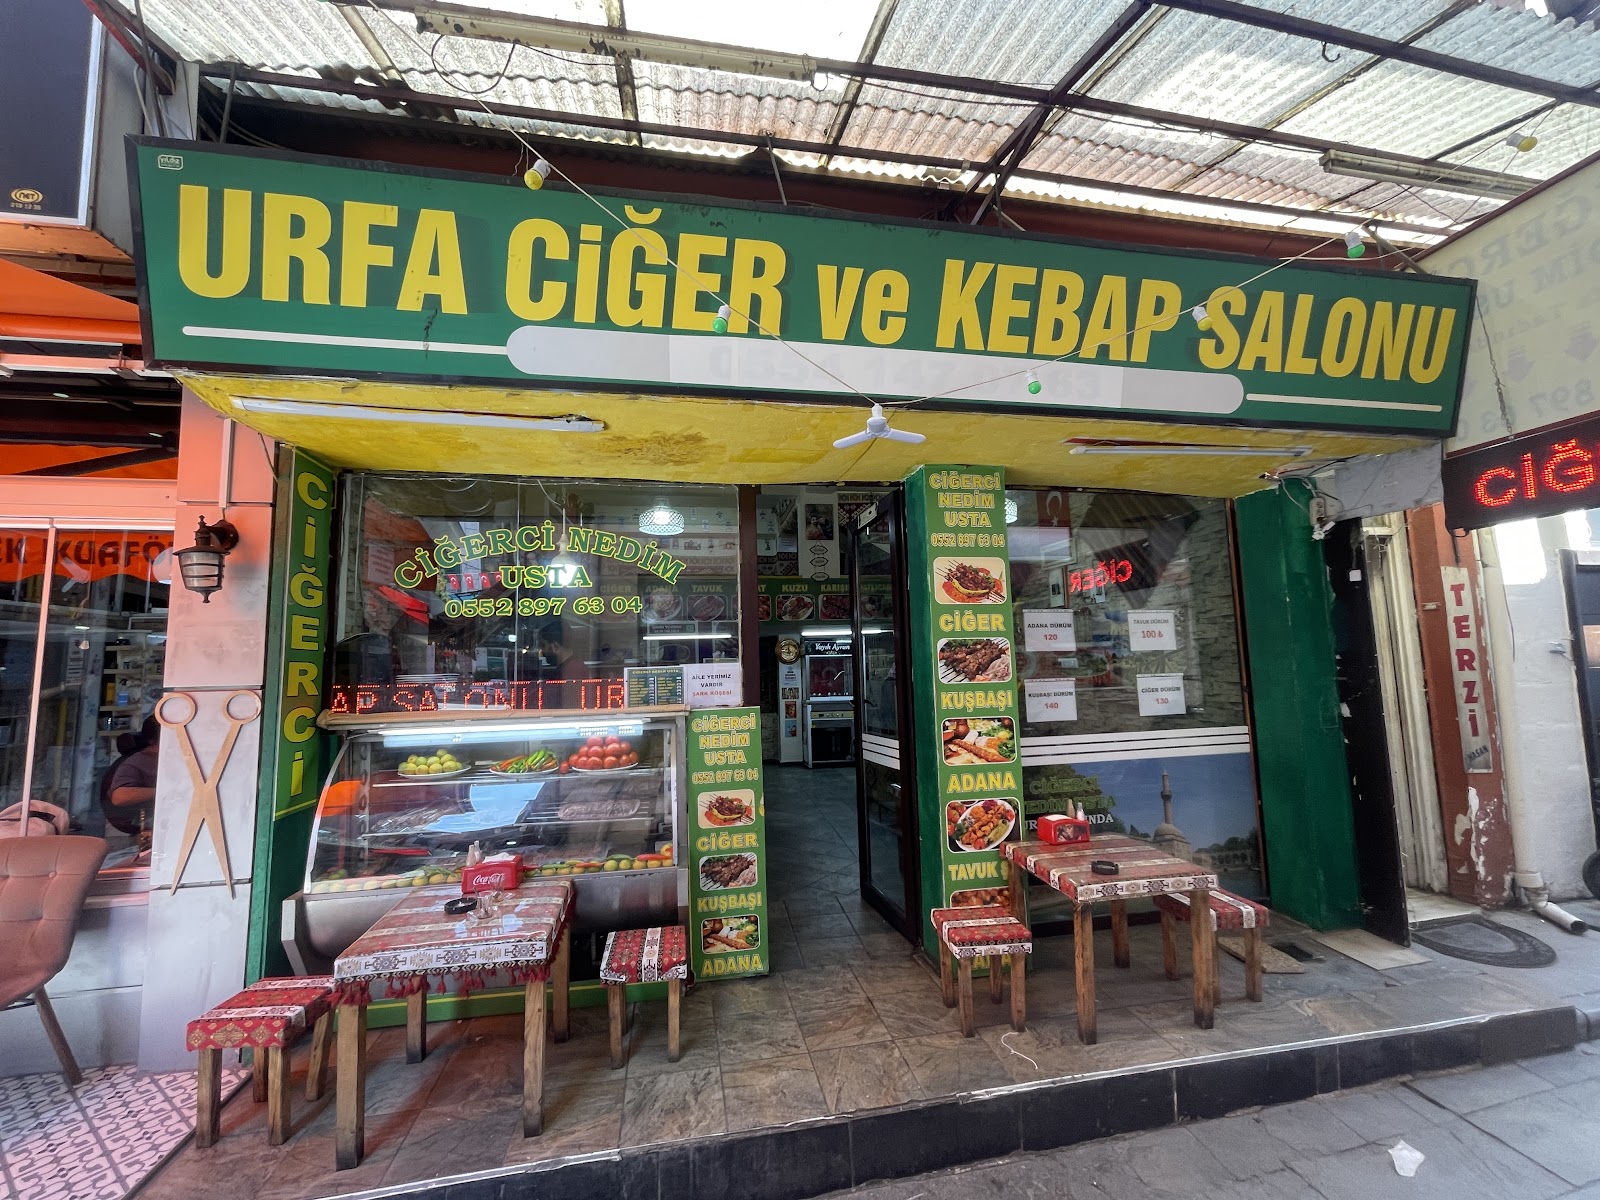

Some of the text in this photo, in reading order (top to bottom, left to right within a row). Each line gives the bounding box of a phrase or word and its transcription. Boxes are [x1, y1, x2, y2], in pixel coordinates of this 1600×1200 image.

[179, 184, 468, 314] URFA
[817, 264, 909, 345] ve
[936, 259, 1182, 363] KEBAP
[1197, 286, 1454, 384] SALONU
[1474, 438, 1600, 507] CİĞ
[938, 490, 995, 508] NEDİM
[944, 511, 992, 527] USTA
[931, 533, 956, 547] 0552
[992, 534, 1005, 547] 04
[52, 536, 173, 567] KUAFÖ
[394, 519, 555, 589] CİĞERCİ
[568, 526, 687, 585] NEDİM
[499, 565, 592, 589] USTA
[692, 584, 723, 593] TAVUK
[781, 584, 808, 592] KUZU
[445, 595, 642, 618] 0552 897 63 04
[939, 610, 1005, 632] CİĞER
[1141, 630, 1156, 639] 100
[941, 690, 1012, 712] KUŞBAŞI
[1044, 702, 1059, 710] 140
[1155, 697, 1169, 705] 130
[699, 731, 750, 749] NEDİM
[704, 750, 747, 765] USTA
[746, 768, 759, 780] 04
[947, 771, 1017, 793] ADANA
[1024, 797, 1069, 814] EDİM
[696, 832, 759, 851] CİĞER
[949, 861, 997, 881] TAVUK
[697, 892, 762, 913] KUŞBAŞI
[702, 954, 763, 977] ADANA
